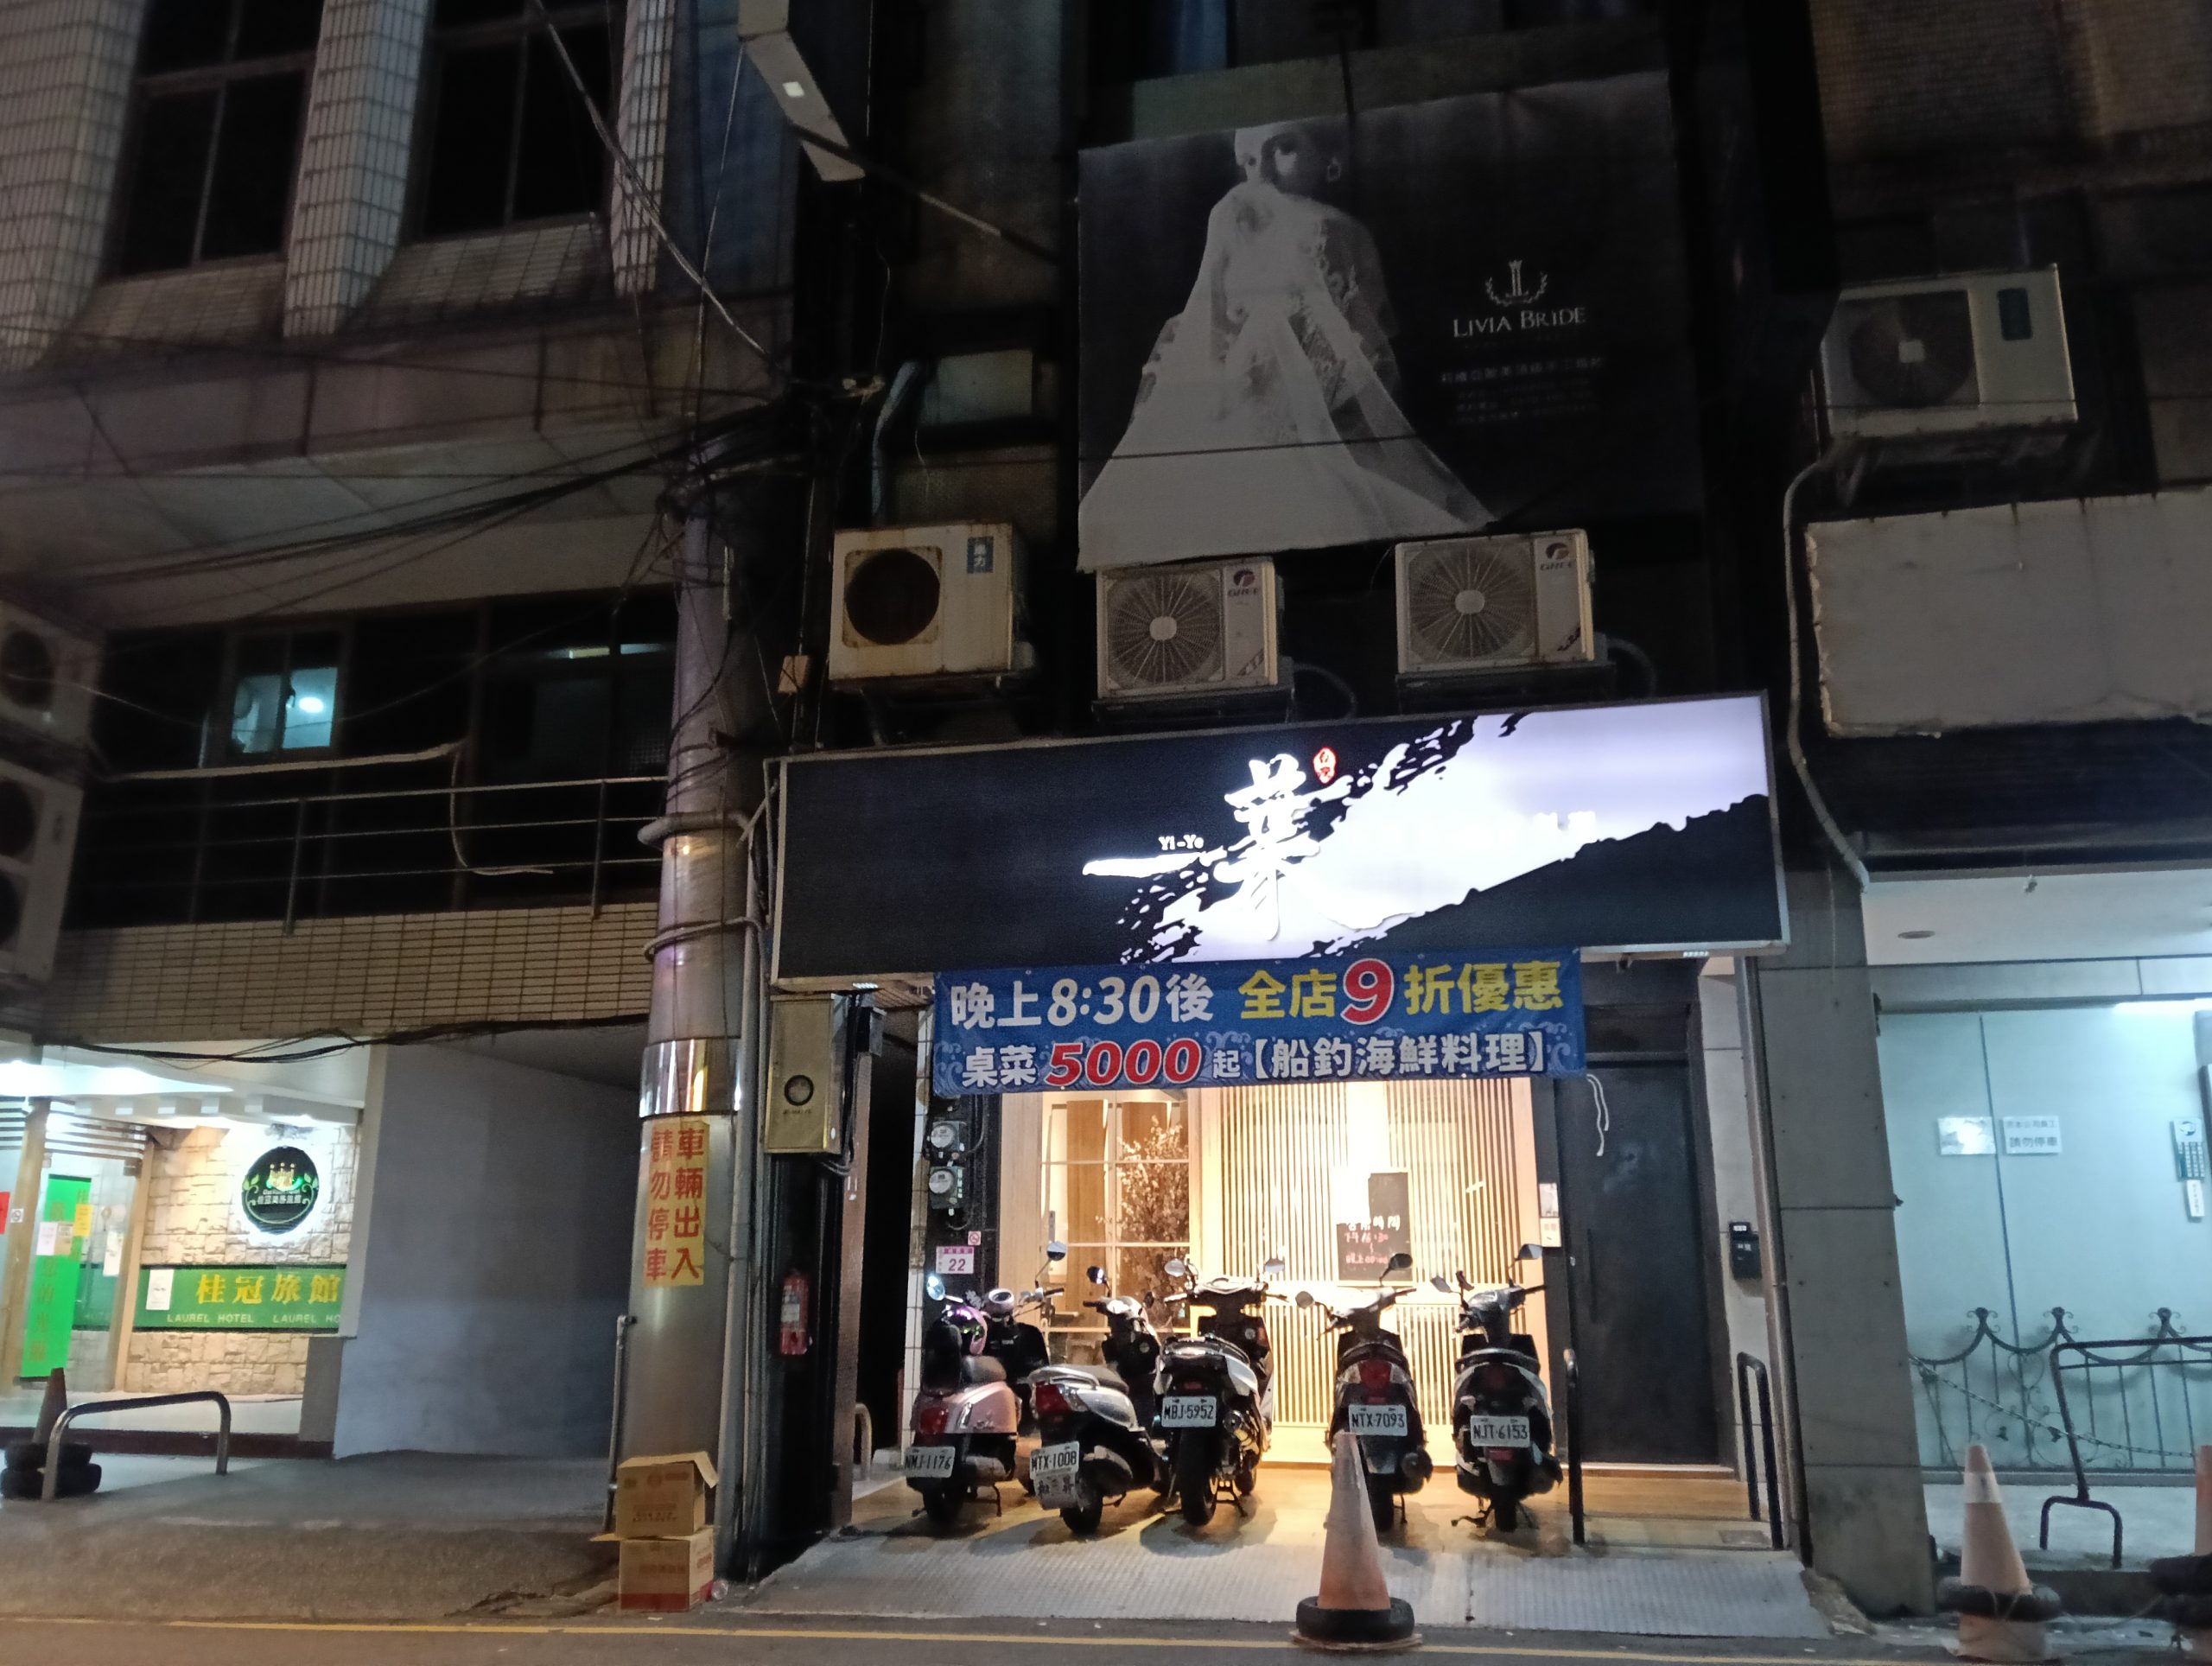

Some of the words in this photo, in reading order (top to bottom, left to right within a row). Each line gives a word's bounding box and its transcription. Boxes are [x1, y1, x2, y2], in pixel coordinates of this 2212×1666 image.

[1452, 316, 1512, 338] LIVIA
[1520, 307, 1586, 329] BRIDE
[1236, 957, 1565, 1026] 全店9折優惠
[2009, 1136, 2058, 1148] 請勿停車
[646, 1129, 674, 1281] 請勿停車
[672, 1128, 705, 1281] 車輛出入
[948, 1257, 966, 1272] 22
[195, 1272, 341, 1306] 桂冠旅館
[167, 1313, 210, 1324] LAUREL
[217, 1313, 255, 1324] HOTEL
[273, 1313, 317, 1325] LAUREL
